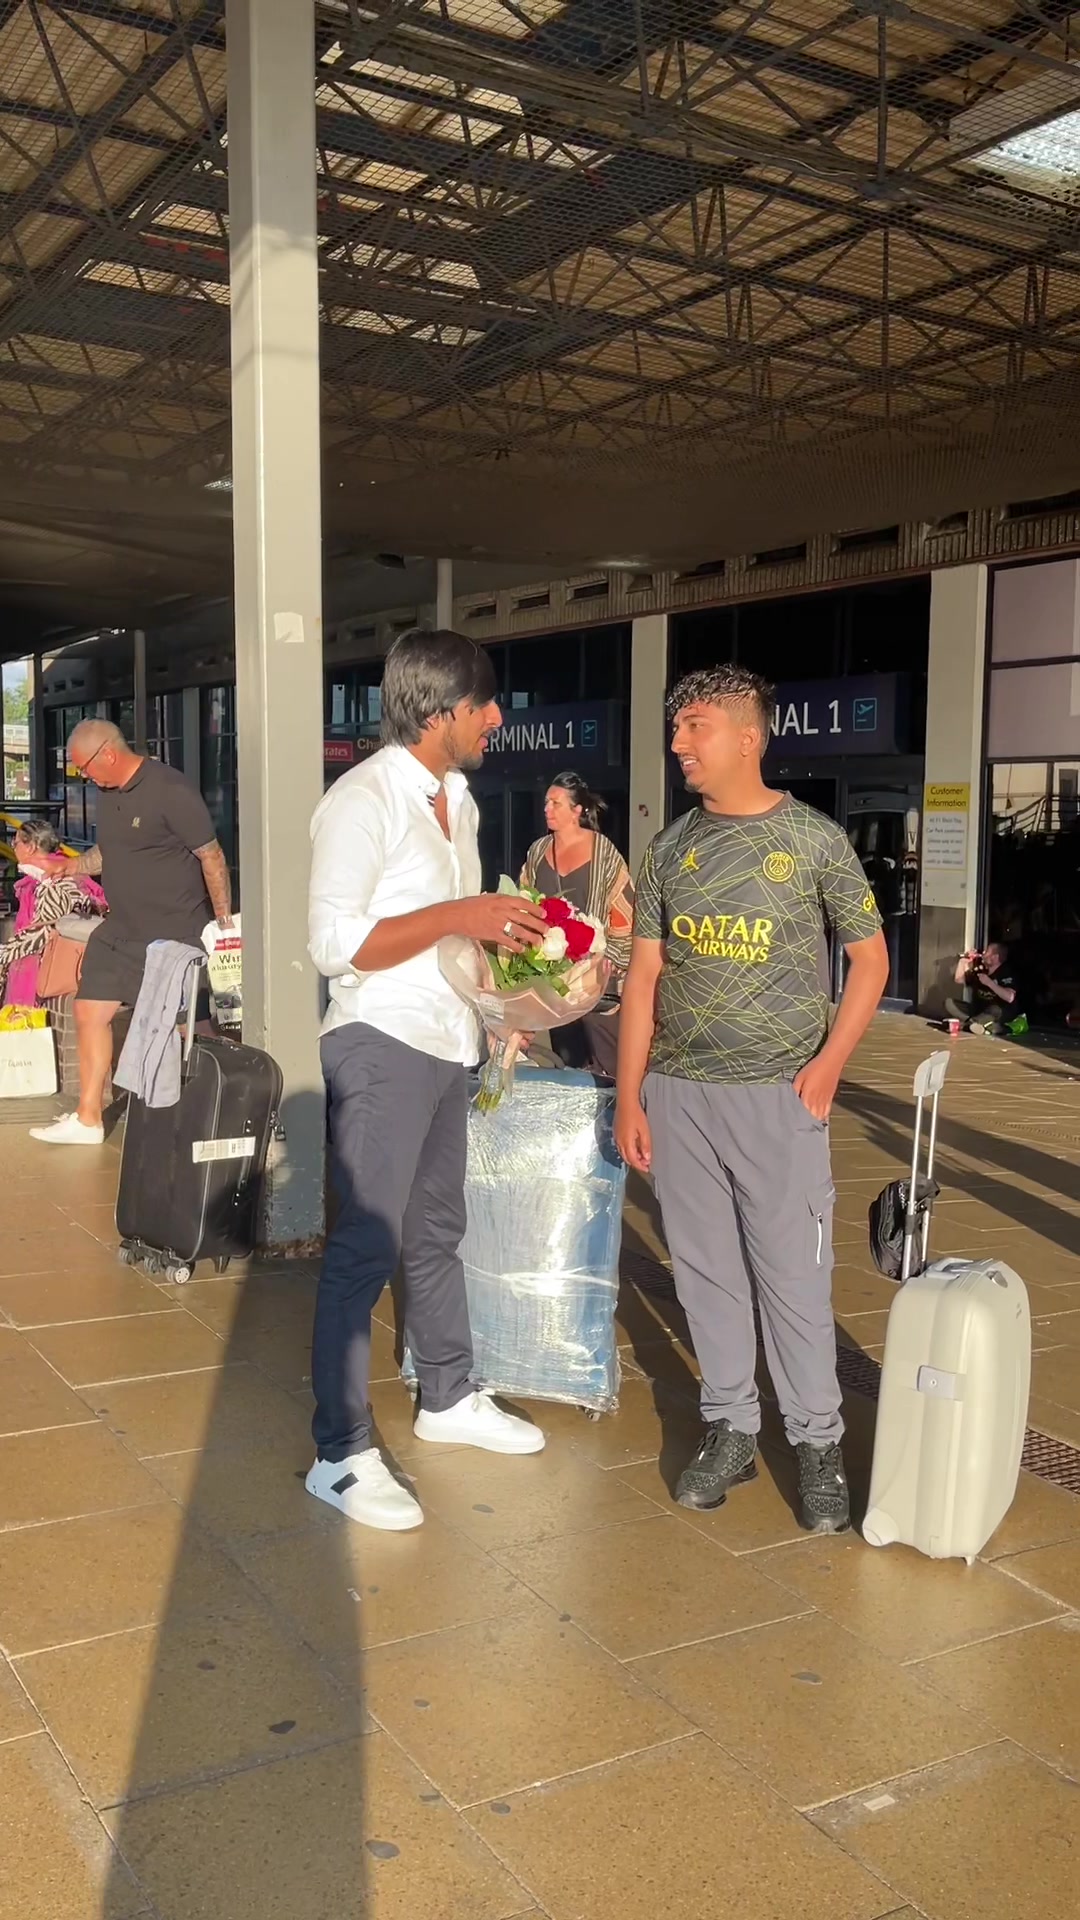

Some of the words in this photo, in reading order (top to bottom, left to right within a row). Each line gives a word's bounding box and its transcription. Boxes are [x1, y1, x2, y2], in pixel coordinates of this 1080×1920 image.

[828, 699, 842, 733] 1
[484, 722, 560, 753] RMINAL
[565, 720, 575, 748] 1
[926, 799, 967, 808] Information
[930, 786, 964, 796] Customer
[671, 915, 773, 945] QATAR
[691, 939, 769, 962] AIRWAYS
